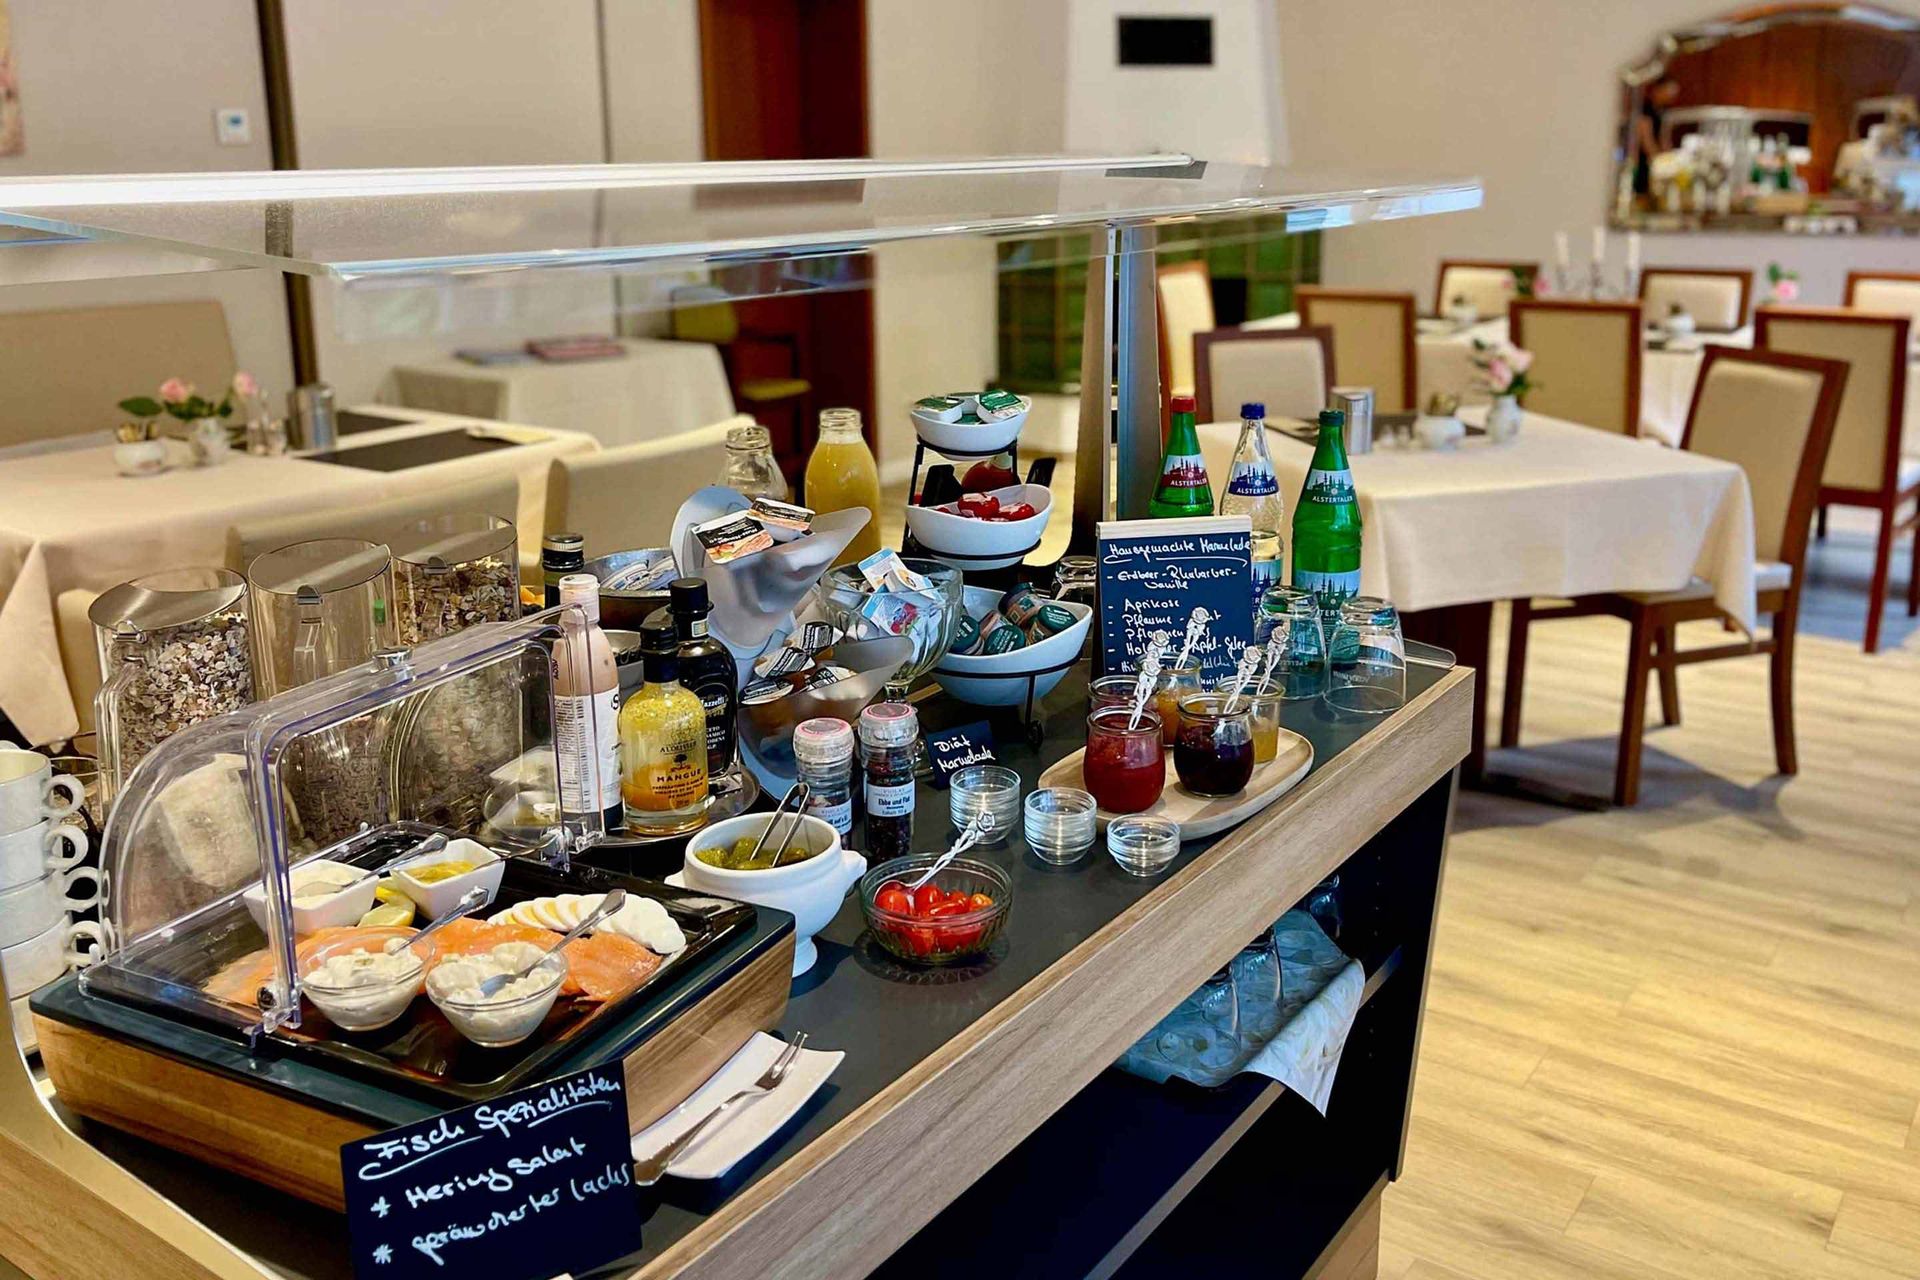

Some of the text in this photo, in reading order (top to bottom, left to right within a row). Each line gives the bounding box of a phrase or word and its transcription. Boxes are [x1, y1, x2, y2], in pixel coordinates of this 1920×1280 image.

[1170, 479, 1207, 487] ALSTERTALER
[1236, 485, 1276, 495] ALSTERTALER
[1312, 495, 1353, 503] ALSTERTALER
[1108, 542, 1194, 563] Hausgemachte
[1124, 598, 1180, 616] Aprikose
[1122, 613, 1172, 627] Pflaume
[933, 734, 970, 752] Diät
[937, 745, 996, 773] Marmelade
[657, 768, 701, 782] MANGUE
[363, 1072, 621, 1161] Fisch Spezialitäten
[405, 1166, 513, 1208] Hering
